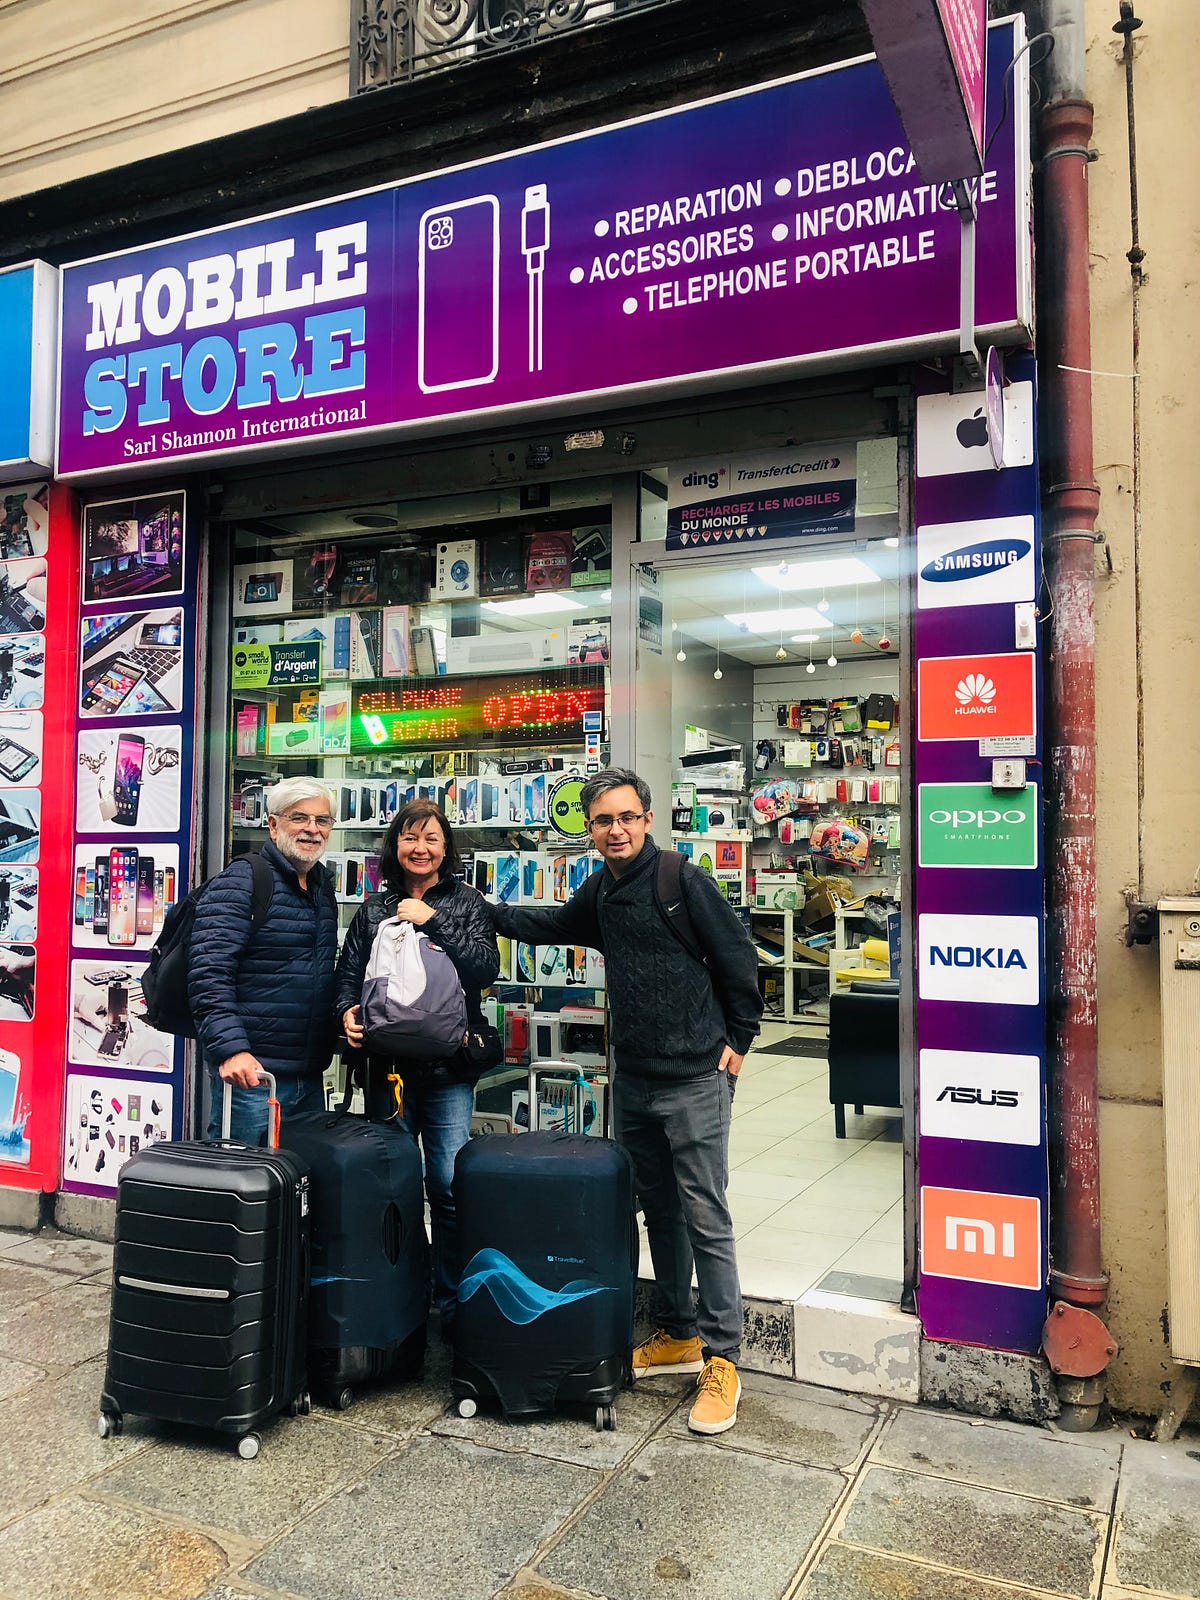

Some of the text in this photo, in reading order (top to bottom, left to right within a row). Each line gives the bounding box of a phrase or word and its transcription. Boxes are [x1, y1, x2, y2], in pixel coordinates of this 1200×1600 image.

[615, 179, 763, 238] REPARATION
[589, 224, 754, 284] ACCESSOIRES
[644, 230, 936, 313] TELEPHONE PORTABLE
[85, 220, 368, 351] MOBILE
[83, 306, 366, 436] STORE
[123, 400, 366, 458] Sarl Shannon International
[682, 459, 830, 489] ding TransfertCredit
[681, 492, 841, 520] RECHARGEZ LES MOBILES
[681, 514, 748, 531] DU MONDE
[934, 550, 1019, 571] SAMSUNG
[274, 659, 317, 673] d'Argent
[275, 649, 306, 660] Transfert
[358, 688, 463, 713] CELLPHONE
[482, 690, 592, 726] OPEN
[954, 705, 997, 715] HUAWEI
[392, 717, 459, 740] REPAIR
[320, 735, 340, 748] Tab
[944, 833, 1012, 841] SMARTPHONE
[722, 846, 736, 861] Ria
[930, 945, 1028, 970] NOKIA
[936, 1086, 1019, 1108] ASUS
